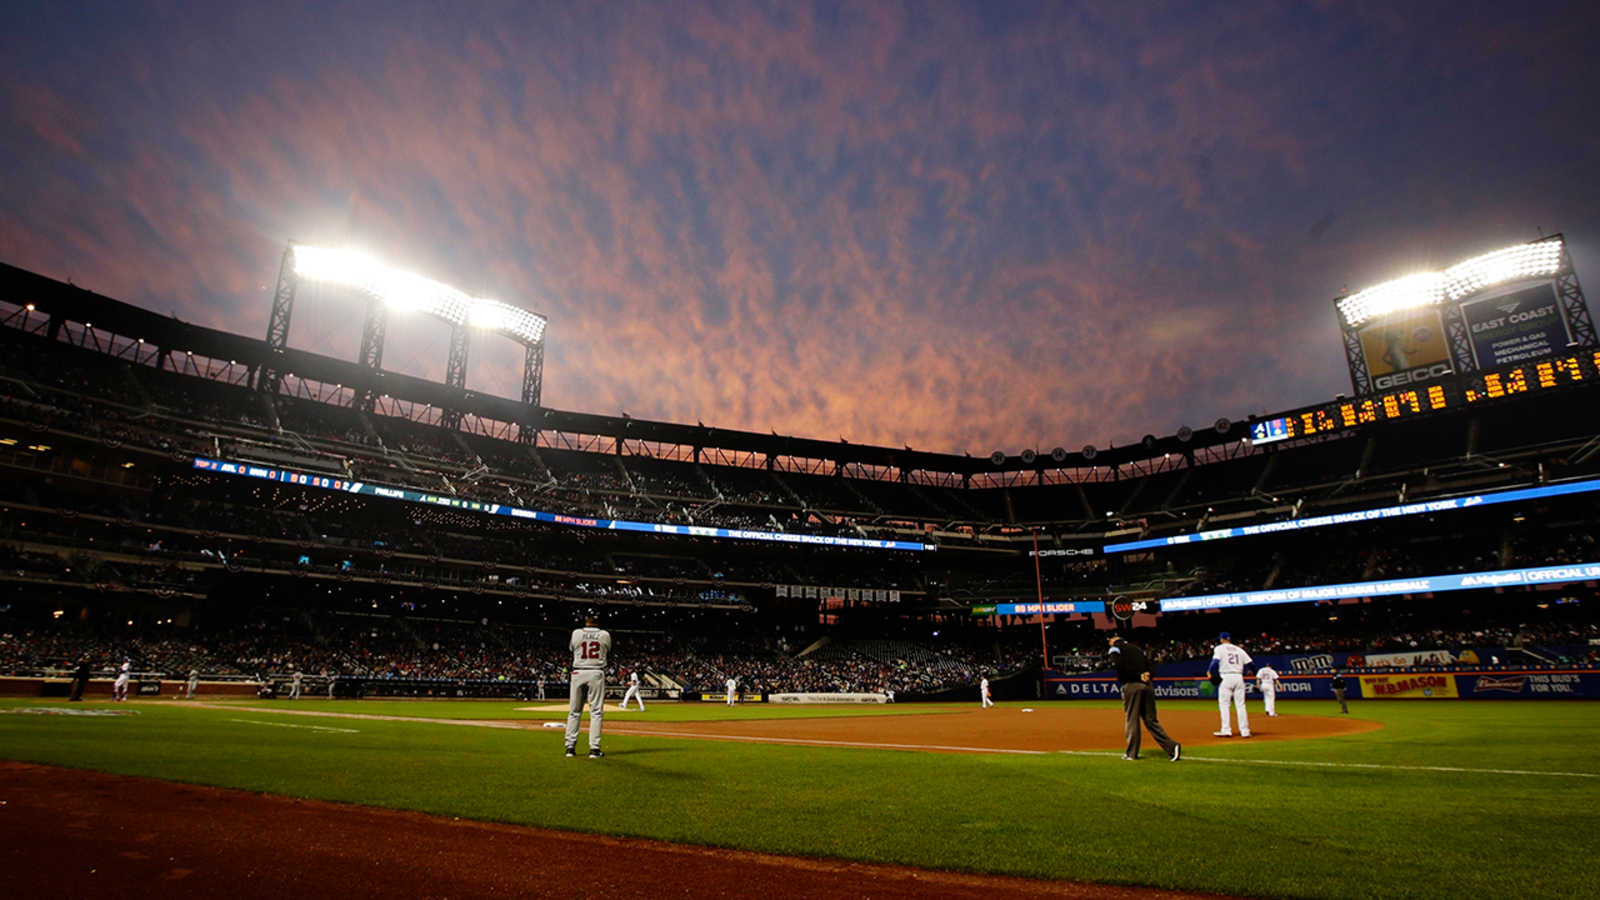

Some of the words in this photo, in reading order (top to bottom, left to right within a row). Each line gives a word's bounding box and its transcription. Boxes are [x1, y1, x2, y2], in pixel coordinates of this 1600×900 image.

[1472, 317, 1506, 334] EAST
[1508, 304, 1556, 324] COAST
[1491, 337, 1522, 349] POWER
[1529, 331, 1548, 342] GAS
[1494, 340, 1550, 356] MECHANICAL
[1496, 347, 1552, 364] PETROLEUM
[1375, 364, 1449, 390] GEICO
[1217, 422, 1228, 430] 42
[1024, 452, 1032, 460] 41
[195, 459, 210, 468] TOP
[221, 464, 236, 473] ATL
[249, 468, 267, 477] NYM
[342, 481, 350, 490] 2
[375, 487, 404, 498] PHILLIPS
[563, 516, 575, 524] MPH
[576, 518, 598, 526] SLIDER
[1243, 525, 1260, 535] THE
[1260, 521, 1298, 533] OFFICIAL
[1298, 516, 1333, 528] CHEESE
[1333, 512, 1366, 523] SNACK
[1366, 509, 1381, 519] OF
[1381, 506, 1402, 517] THE
[1403, 503, 1427, 514] NEW
[1427, 499, 1458, 511] YORK
[727, 529, 742, 538] THE
[743, 531, 774, 541] OFFICIAL
[775, 533, 801, 543] CHEESE
[801, 535, 824, 544] SNACK
[824, 536, 835, 545] OF
[835, 537, 848, 546] THE
[848, 538, 864, 547] NEW
[864, 539, 882, 548] YORK
[1028, 548, 1094, 557] PORSCHE
[1526, 567, 1585, 581] OFFICIAL
[1205, 596, 1242, 607] OFFICIAL
[1246, 592, 1287, 603] UNIFORM
[1287, 590, 1301, 600] OF
[1302, 588, 1337, 599] MAJOR
[1337, 584, 1376, 596] LEAGUE
[1376, 580, 1430, 593] BASEBALL
[1027, 604, 1046, 612] MPH
[1046, 603, 1075, 612] SLIDER
[581, 641, 600, 659] 12
[1228, 653, 1239, 665] 21
[1393, 656, 1407, 665] Go
[1529, 675, 1550, 683] THIS
[1550, 674, 1581, 683] BUD'S
[1071, 684, 1118, 694] DELTA
[1154, 685, 1199, 697] dvisors
[1530, 684, 1550, 692] FOR
[1550, 683, 1574, 693] YOU.
